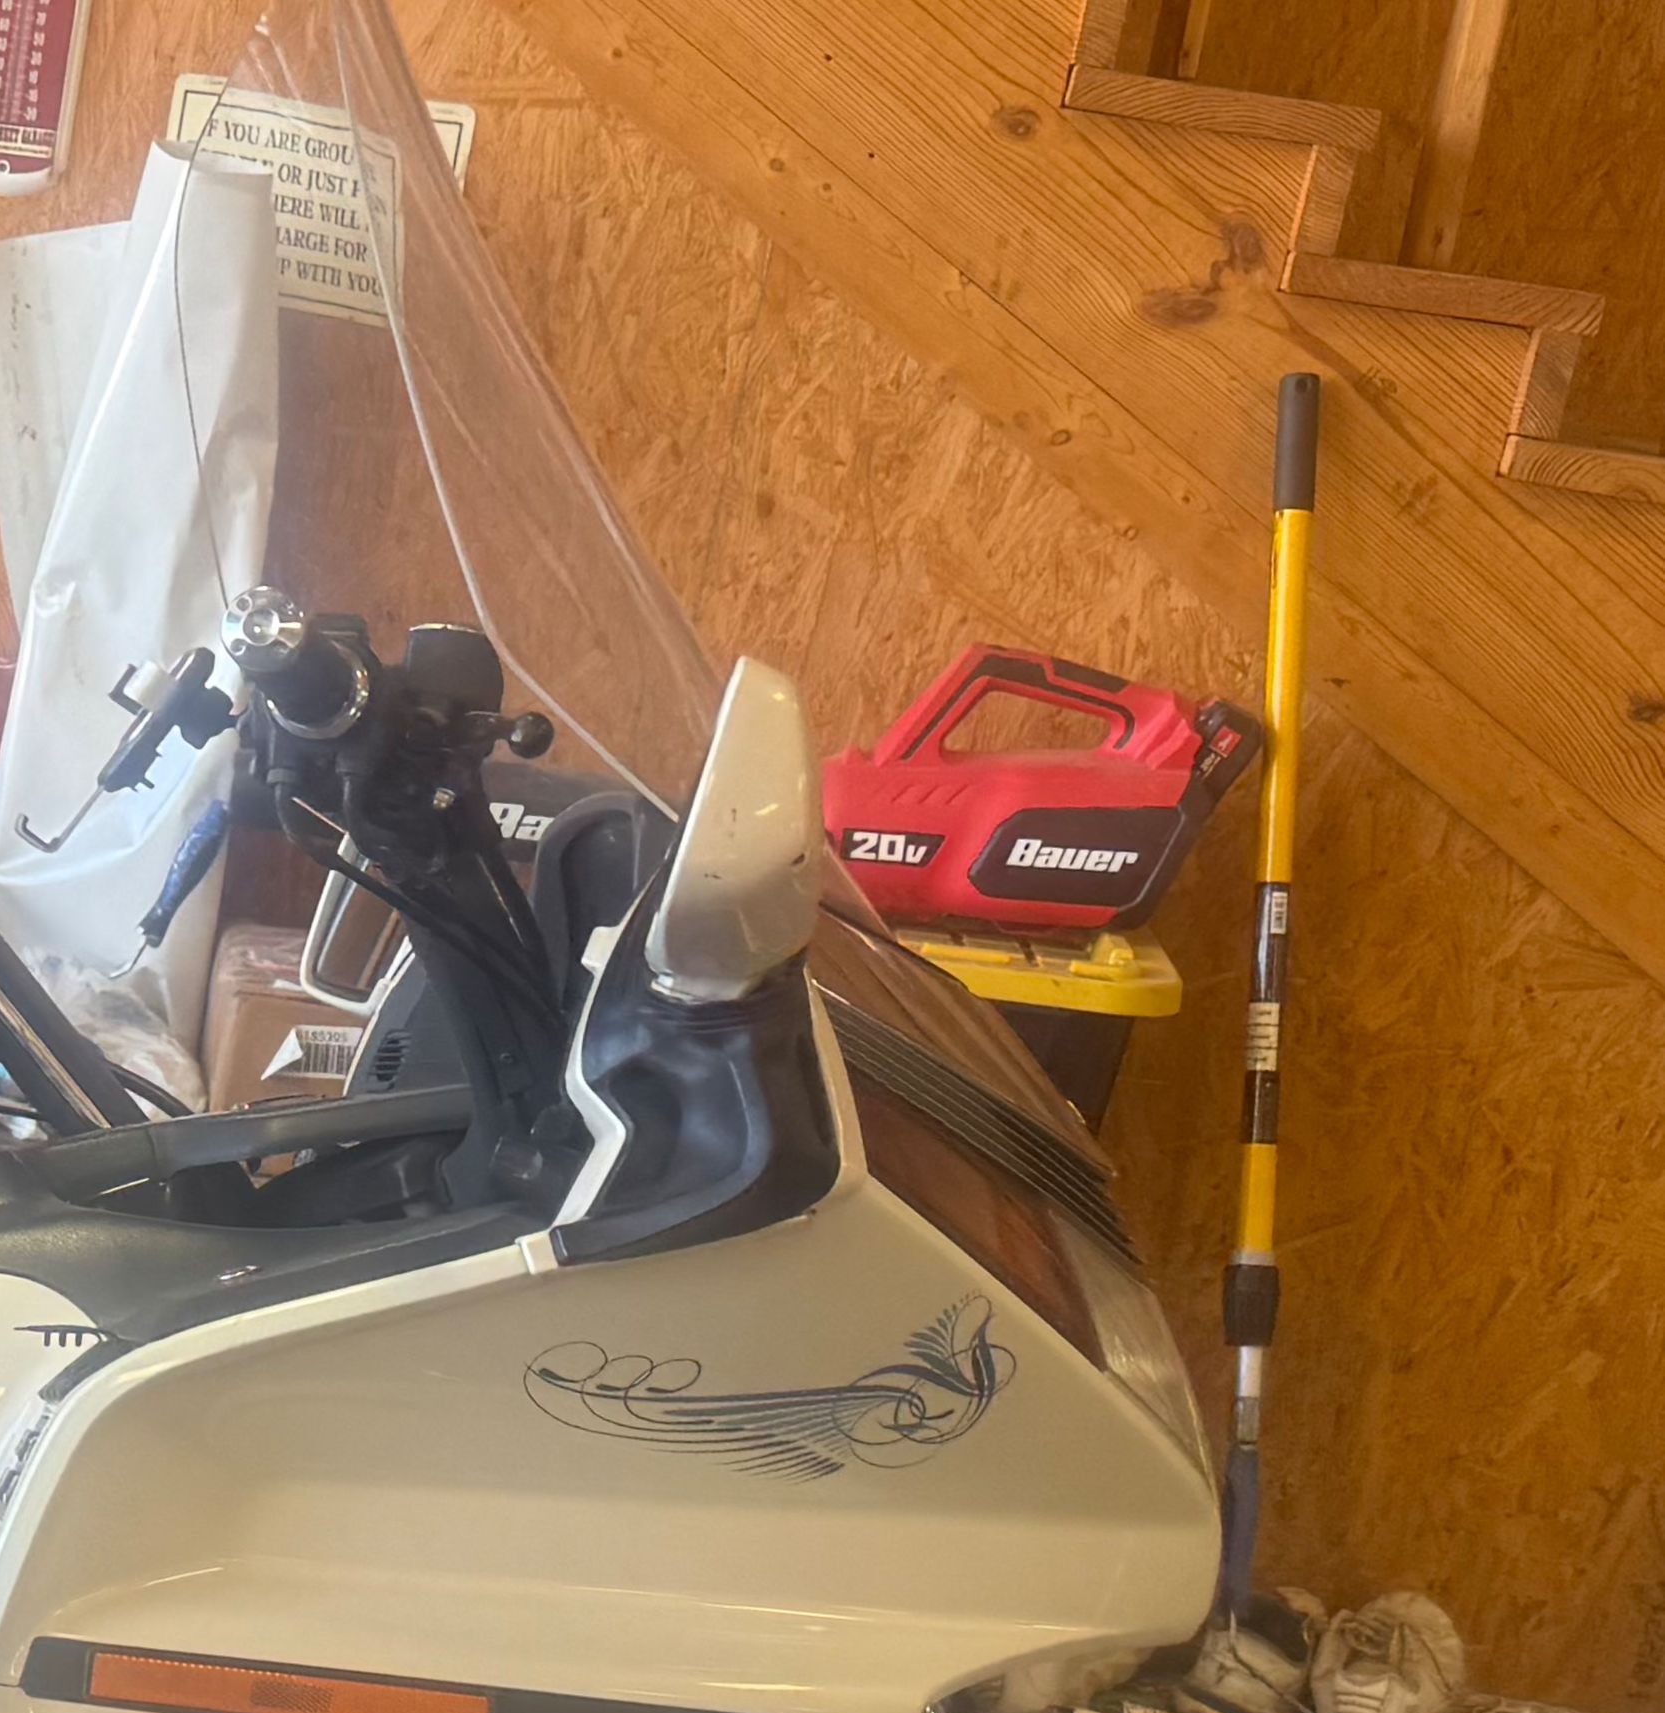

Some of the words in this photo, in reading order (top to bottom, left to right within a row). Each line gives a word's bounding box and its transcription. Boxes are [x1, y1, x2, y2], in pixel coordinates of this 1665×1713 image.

[225, 120, 260, 146] YOU
[264, 128, 302, 154] ARE
[304, 136, 355, 166] GROU
[277, 162, 303, 187] OR
[306, 168, 348, 197] JUST
[319, 202, 361, 231] WILL
[334, 236, 368, 263] FOR
[296, 261, 341, 288] WITH
[1006, 838, 1138, 873] Bauer
